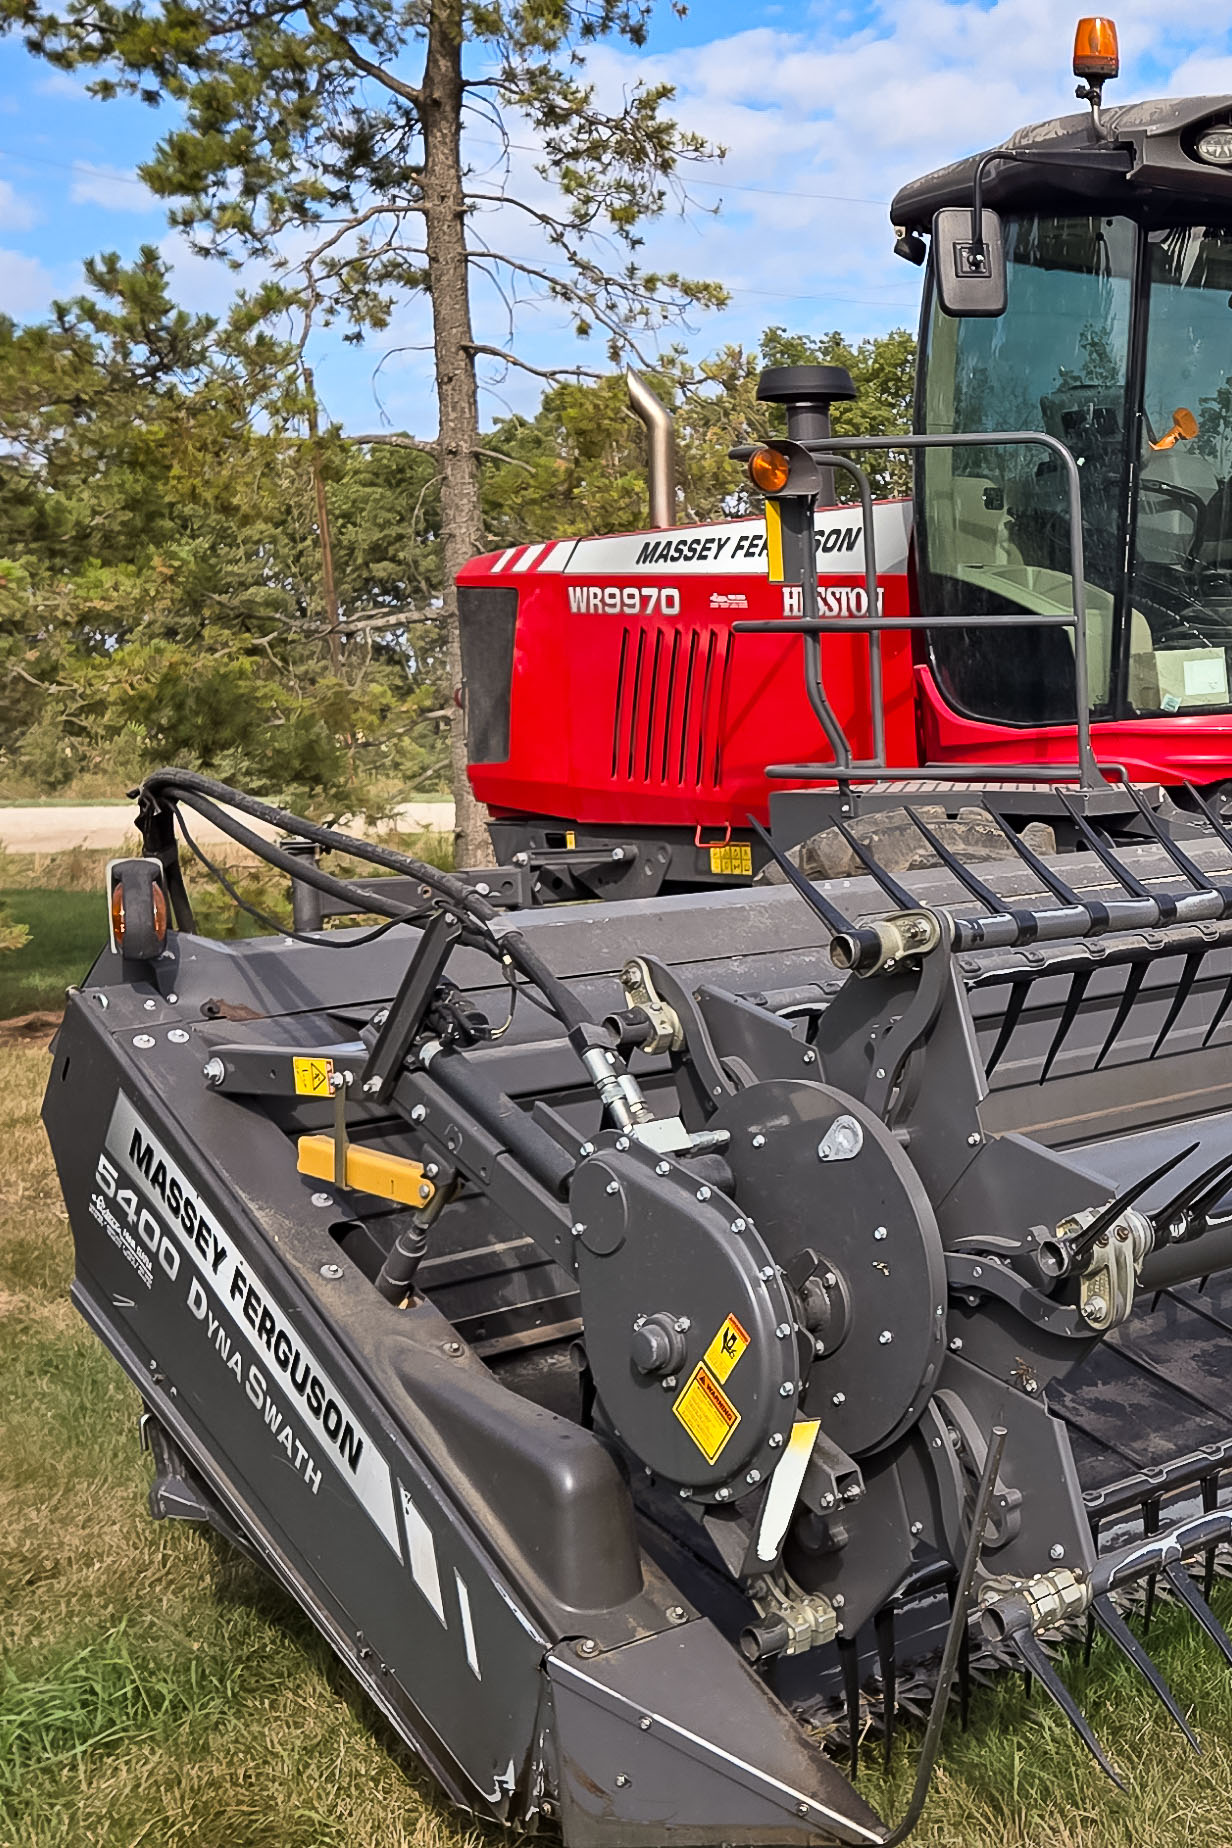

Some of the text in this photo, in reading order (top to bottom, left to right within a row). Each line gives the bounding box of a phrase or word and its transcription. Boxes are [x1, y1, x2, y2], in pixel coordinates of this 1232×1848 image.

[635, 536, 730, 565] MASSEY
[568, 586, 680, 615] WR9970
[95, 1153, 180, 1281] 5400
[129, 1127, 363, 1475] MASSEY FERGUSON
[706, 1383, 733, 1422] WARNING
